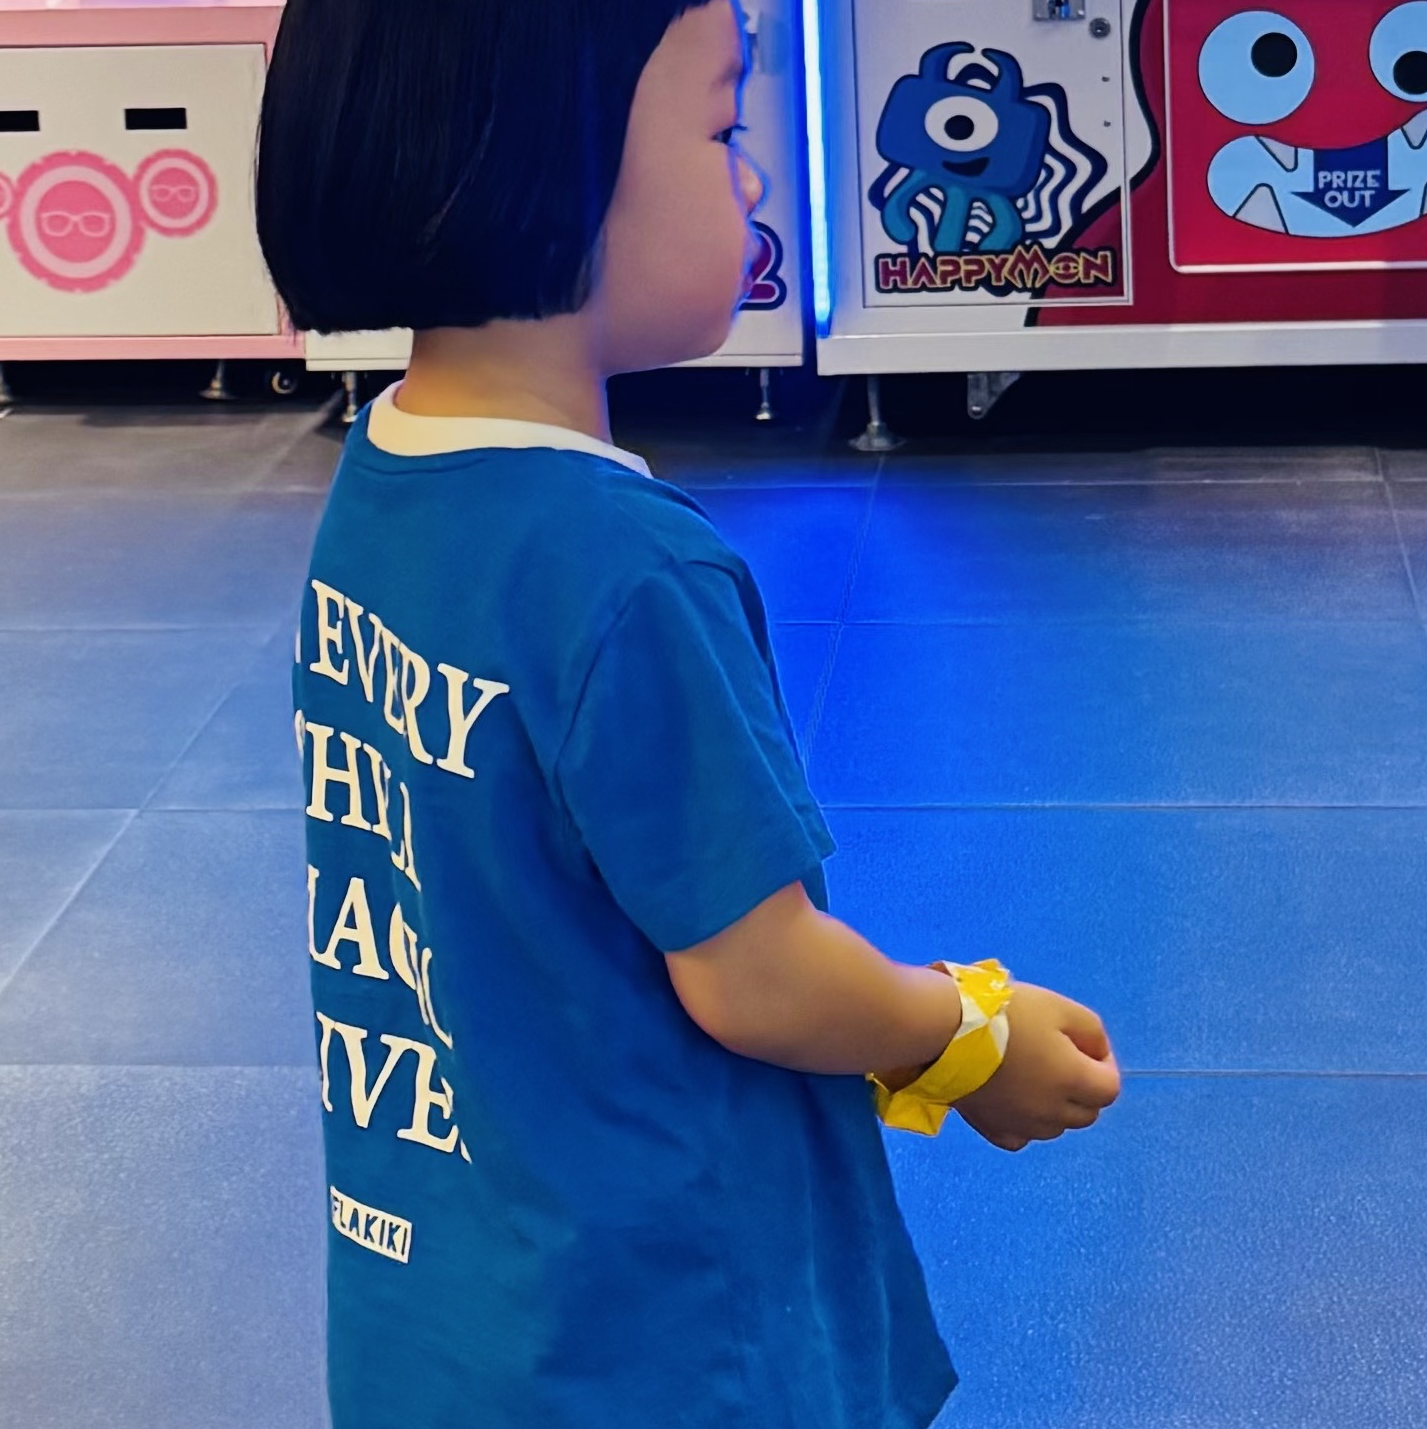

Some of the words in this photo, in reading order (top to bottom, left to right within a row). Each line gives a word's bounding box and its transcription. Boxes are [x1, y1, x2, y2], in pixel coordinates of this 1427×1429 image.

[1318, 170, 1381, 189] PRIZE
[1324, 189, 1375, 208] OUT
[879, 245, 1113, 289] HAPPYMON
[309, 579, 510, 779] EVERY
